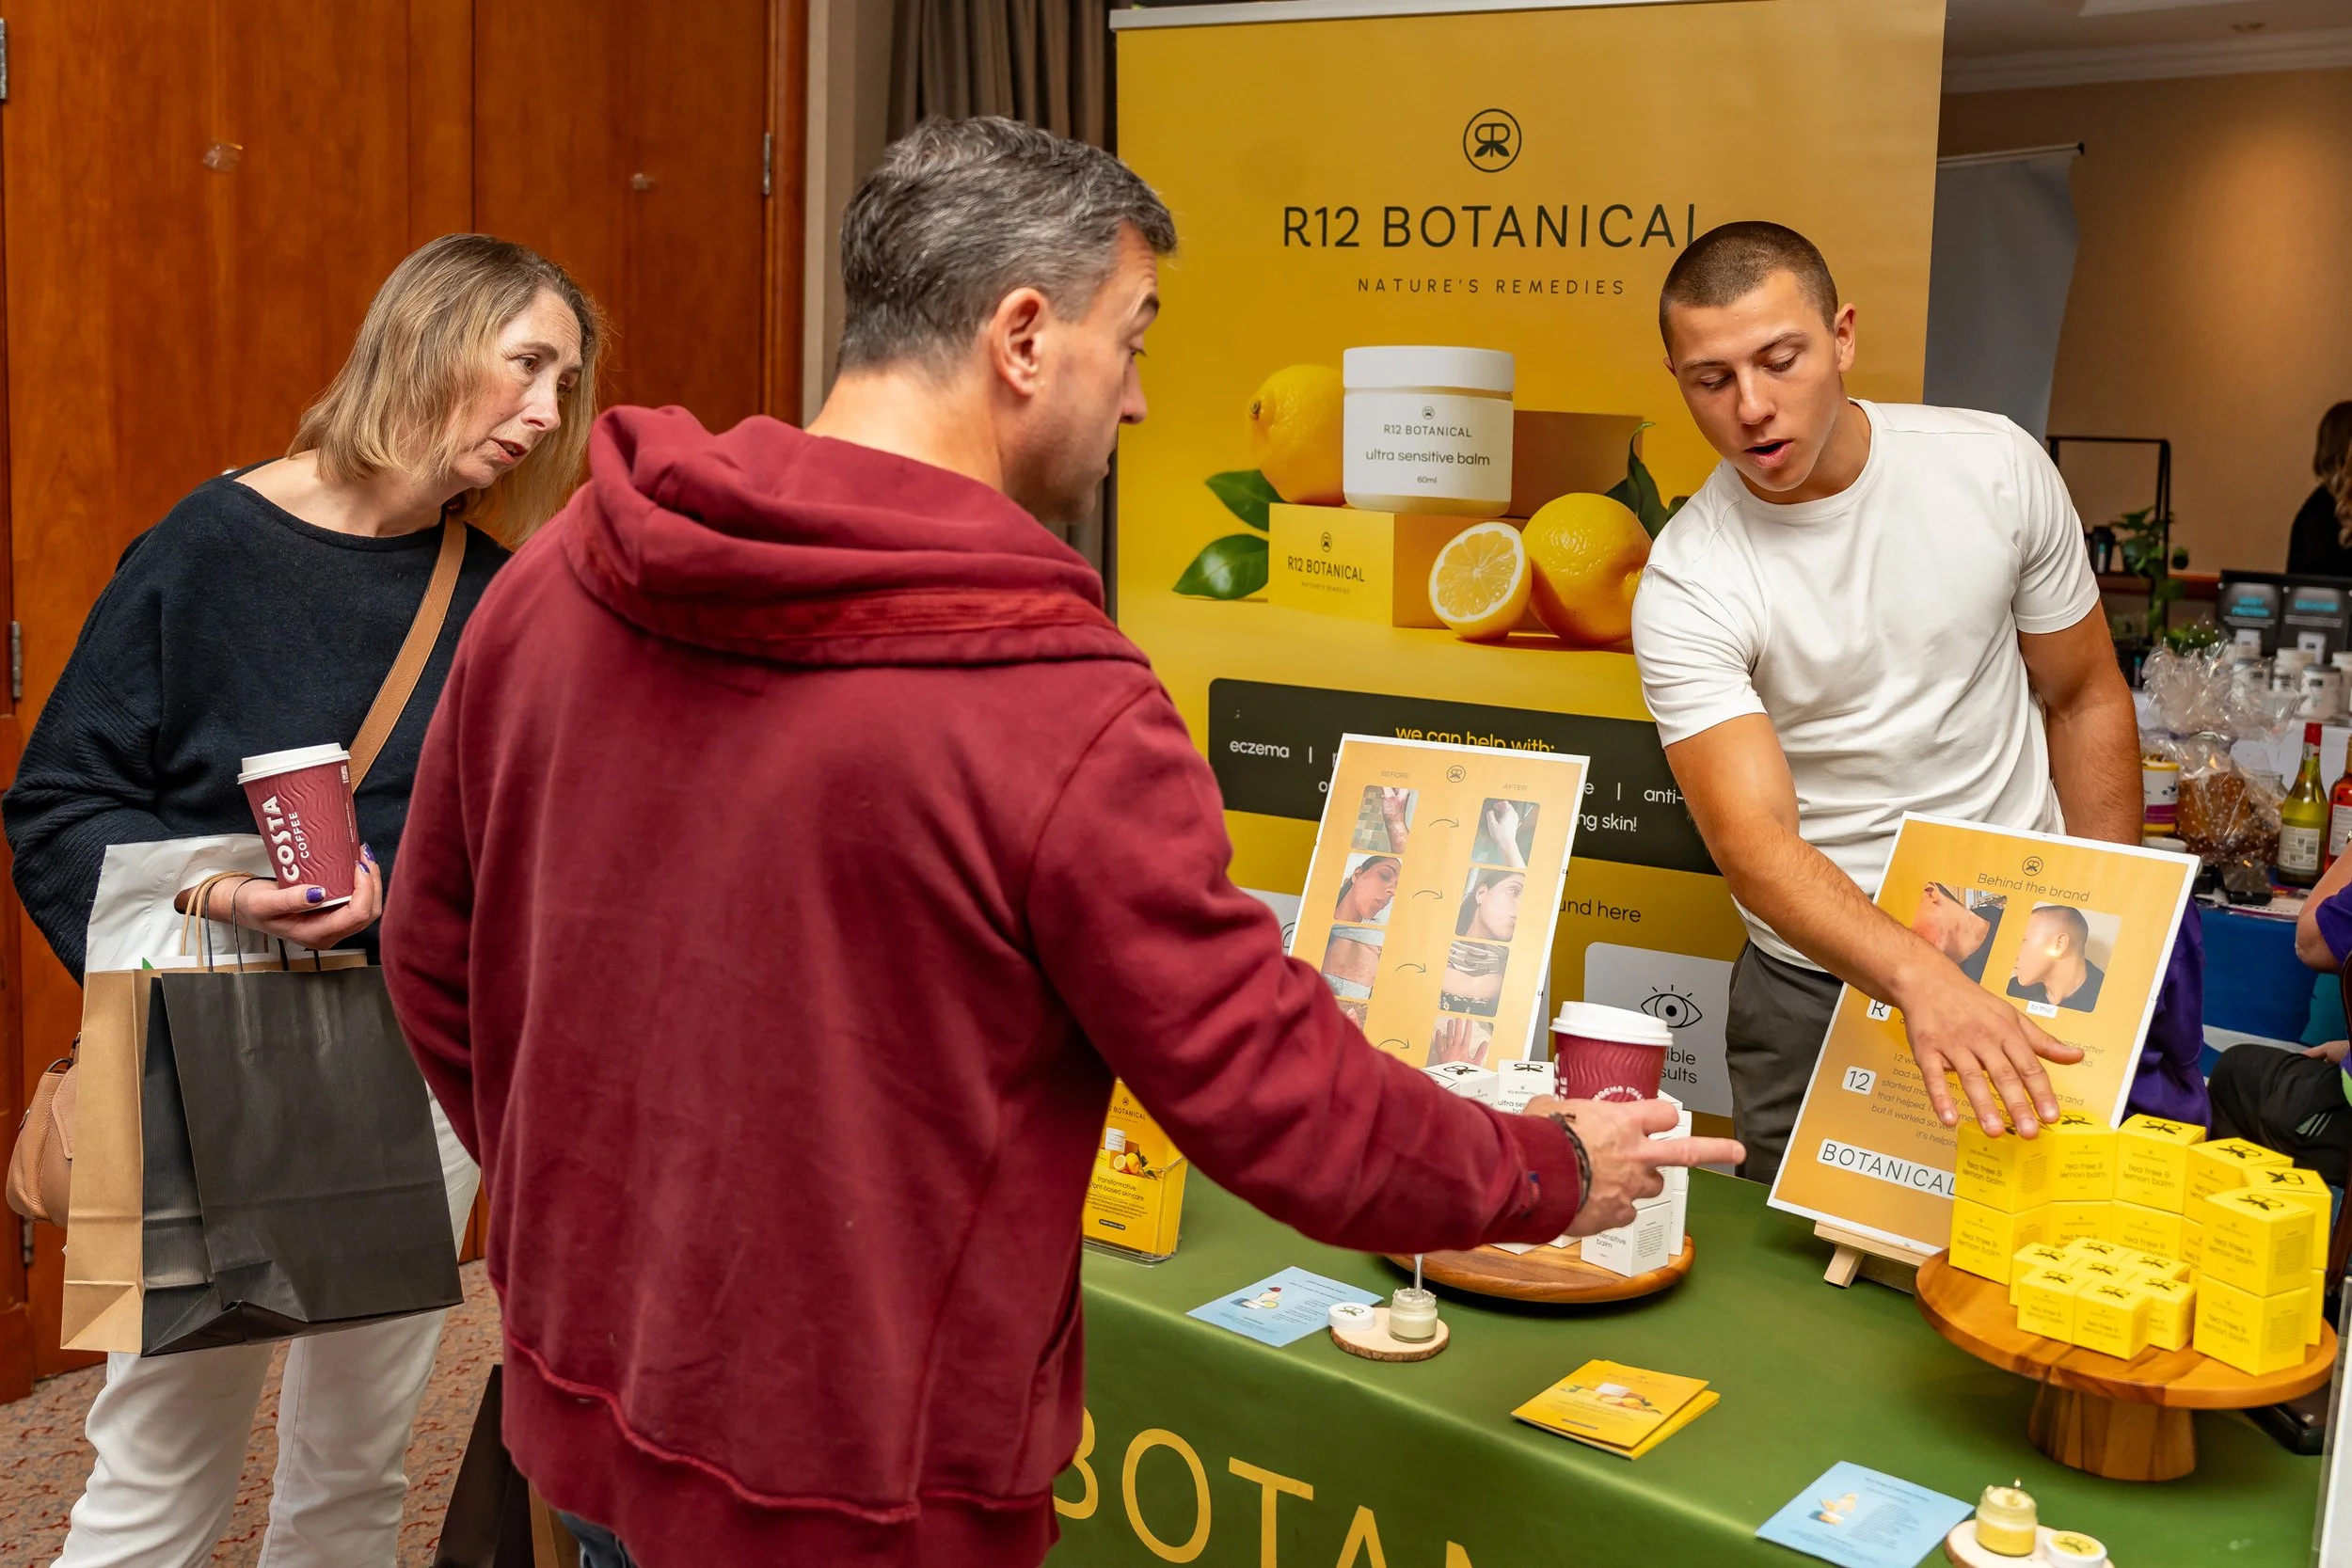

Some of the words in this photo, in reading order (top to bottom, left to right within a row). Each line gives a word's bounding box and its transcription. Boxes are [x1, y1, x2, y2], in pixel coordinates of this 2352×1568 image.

[1283, 206, 1359, 247] R12
[1358, 277, 1480, 293] NATURE'S
[1496, 278, 1625, 294] REMEDIES
[1383, 424, 1402, 435] R12
[1405, 425, 1472, 438] BOTANICAL
[1365, 449, 1395, 461] ultra
[1398, 451, 1454, 464] sensitive
[1457, 452, 1490, 466] balm
[1287, 555, 1304, 572] R12
[1306, 559, 1365, 582] BOTANICAL
[1396, 727, 1422, 740] we
[1426, 730, 1462, 744] can
[1230, 740, 1290, 758] eczema
[1381, 770, 1410, 780] BEFORE
[1503, 784, 1528, 792] AFTER
[1601, 813, 1637, 832] skin!
[262, 795, 300, 882] COSTA
[288, 811, 310, 859] COFFEE
[1978, 873, 2024, 891] Behind
[2026, 881, 2046, 895] the
[2049, 886, 2090, 902] brand
[1597, 900, 1642, 923] here
[1871, 999, 1884, 1017] R
[1666, 1046, 1696, 1065] ible
[2082, 1043, 2106, 1054] after
[1894, 1053, 1904, 1062] 12
[1661, 1068, 1697, 1085] sults
[1850, 1070, 1871, 1091] 12
[1893, 1067, 1910, 1078] bad
[1882, 1079, 1914, 1093] started
[1877, 1091, 1894, 1102] that
[1896, 1096, 1927, 1111] helped.
[2064, 1096, 2085, 1107] and
[1113, 1106, 1147, 1120] BOTANICAL
[1871, 1104, 1887, 1115] but
[1887, 1108, 1894, 1117] it
[1895, 1111, 1926, 1126] worked
[1926, 1119, 1937, 1128] so
[1822, 1143, 1955, 1196] BOTANICAL
[2128, 1164, 2143, 1173] tea
[2145, 1166, 2162, 1177] tree
[1097, 1176, 1136, 1191] transformative
[2122, 1170, 2151, 1183] lemon
[2152, 1178, 2175, 1188] balm
[1121, 1190, 1144, 1202] skincare
[1596, 1238, 1613, 1249] balm
